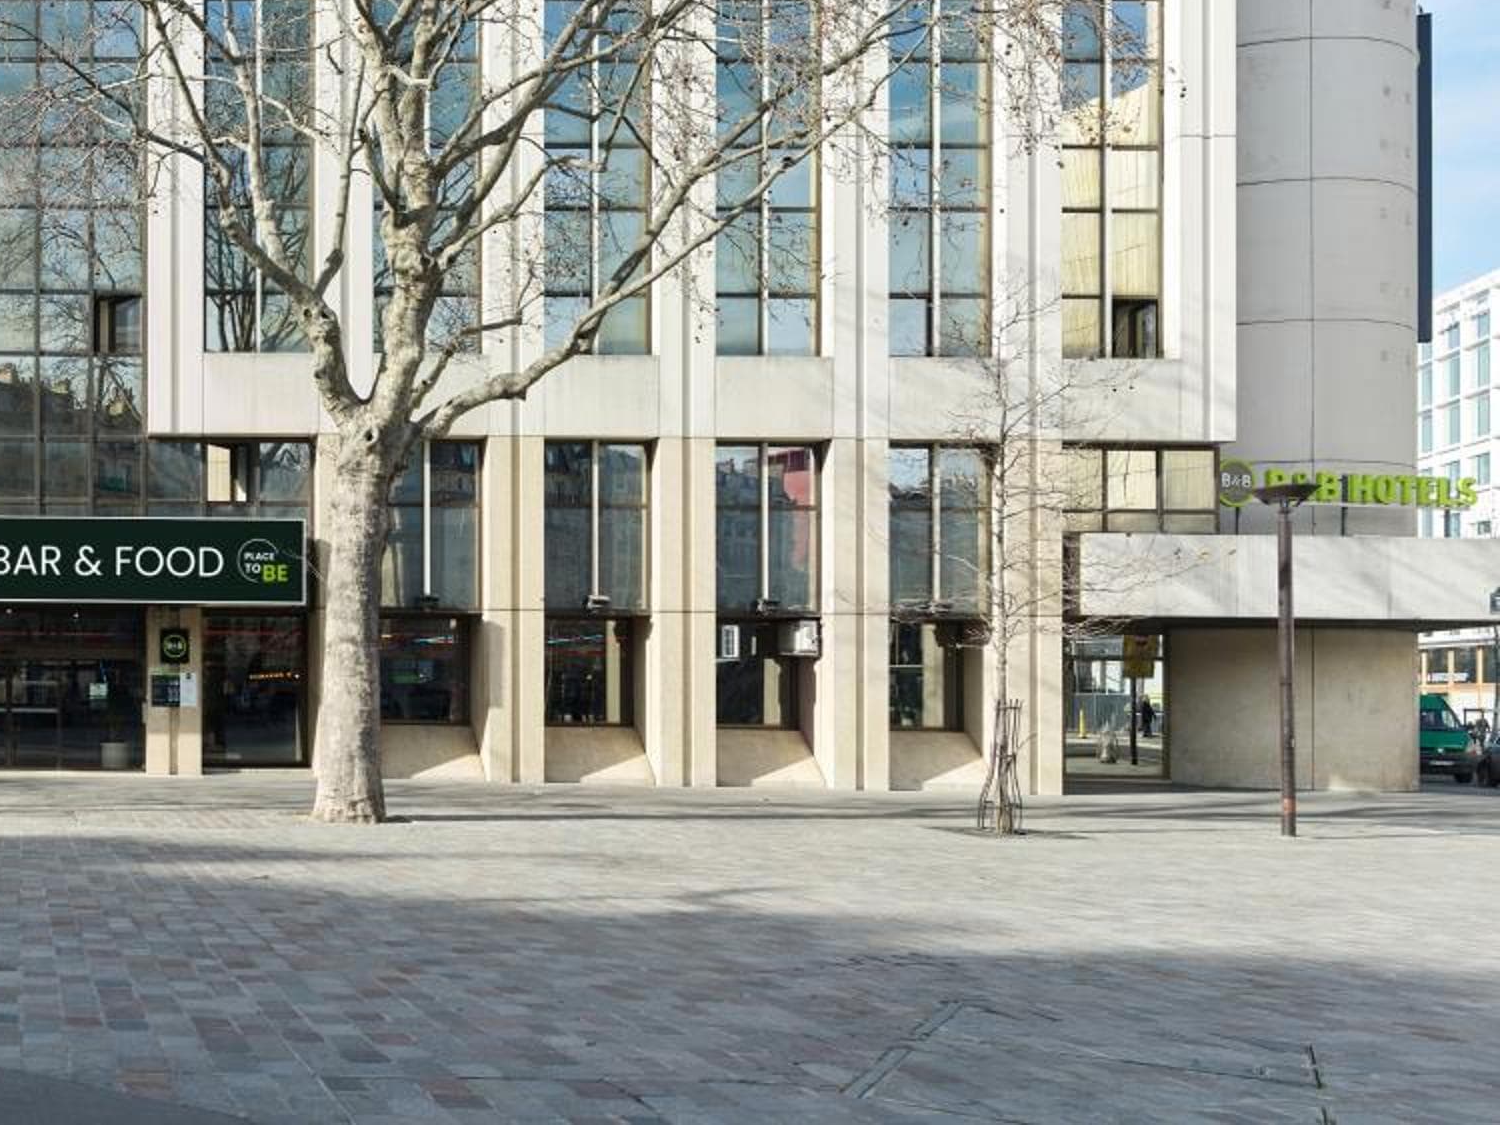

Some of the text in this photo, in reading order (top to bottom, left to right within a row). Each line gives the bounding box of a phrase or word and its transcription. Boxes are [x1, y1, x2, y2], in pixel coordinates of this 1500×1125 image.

[1347, 474, 1477, 507] HOTELS
[74, 544, 103, 576] &
[115, 546, 224, 577] FOOD
[244, 552, 275, 562] PLACE
[245, 563, 289, 582] TO BE
